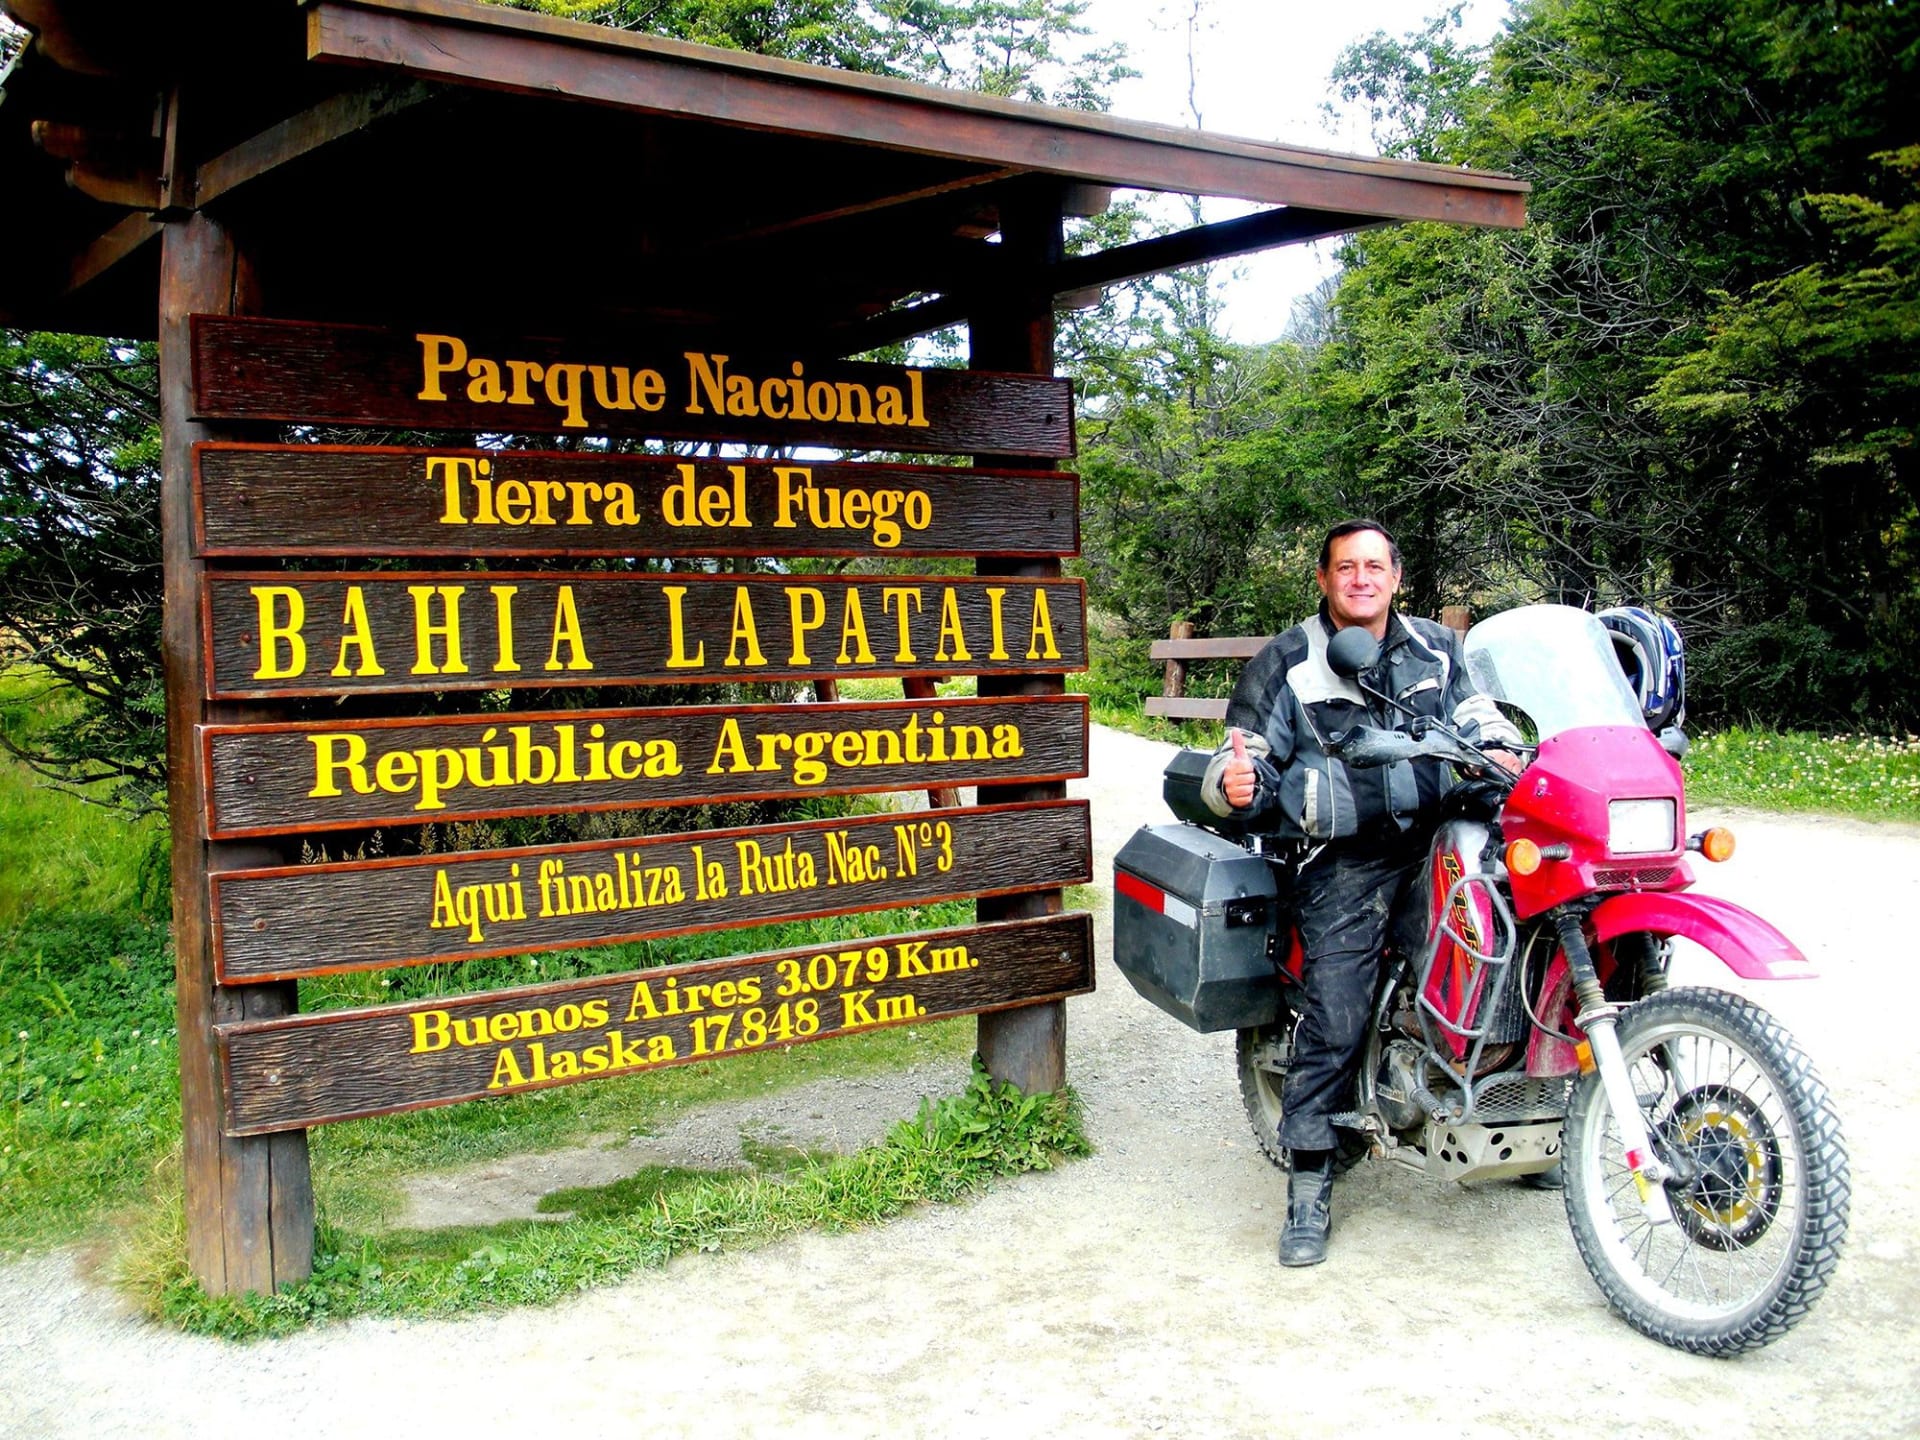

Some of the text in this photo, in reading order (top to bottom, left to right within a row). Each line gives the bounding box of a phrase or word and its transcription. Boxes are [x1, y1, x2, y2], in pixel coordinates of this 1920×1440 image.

[416, 333, 930, 428] Parque Nacional
[426, 456, 933, 548] Tierra del Fuego
[250, 585, 594, 681] BAHIA
[307, 710, 1025, 811] República Argentina
[430, 863, 528, 944] Aqui
[536, 851, 686, 918] finaliza
[691, 844, 729, 901] la
[735, 837, 818, 897] Ruta
[824, 829, 889, 886] Nac.
[408, 940, 980, 1055] Buenos Aires 3.079 Km.
[487, 989, 928, 1091] Alaska 17.848 Km.
